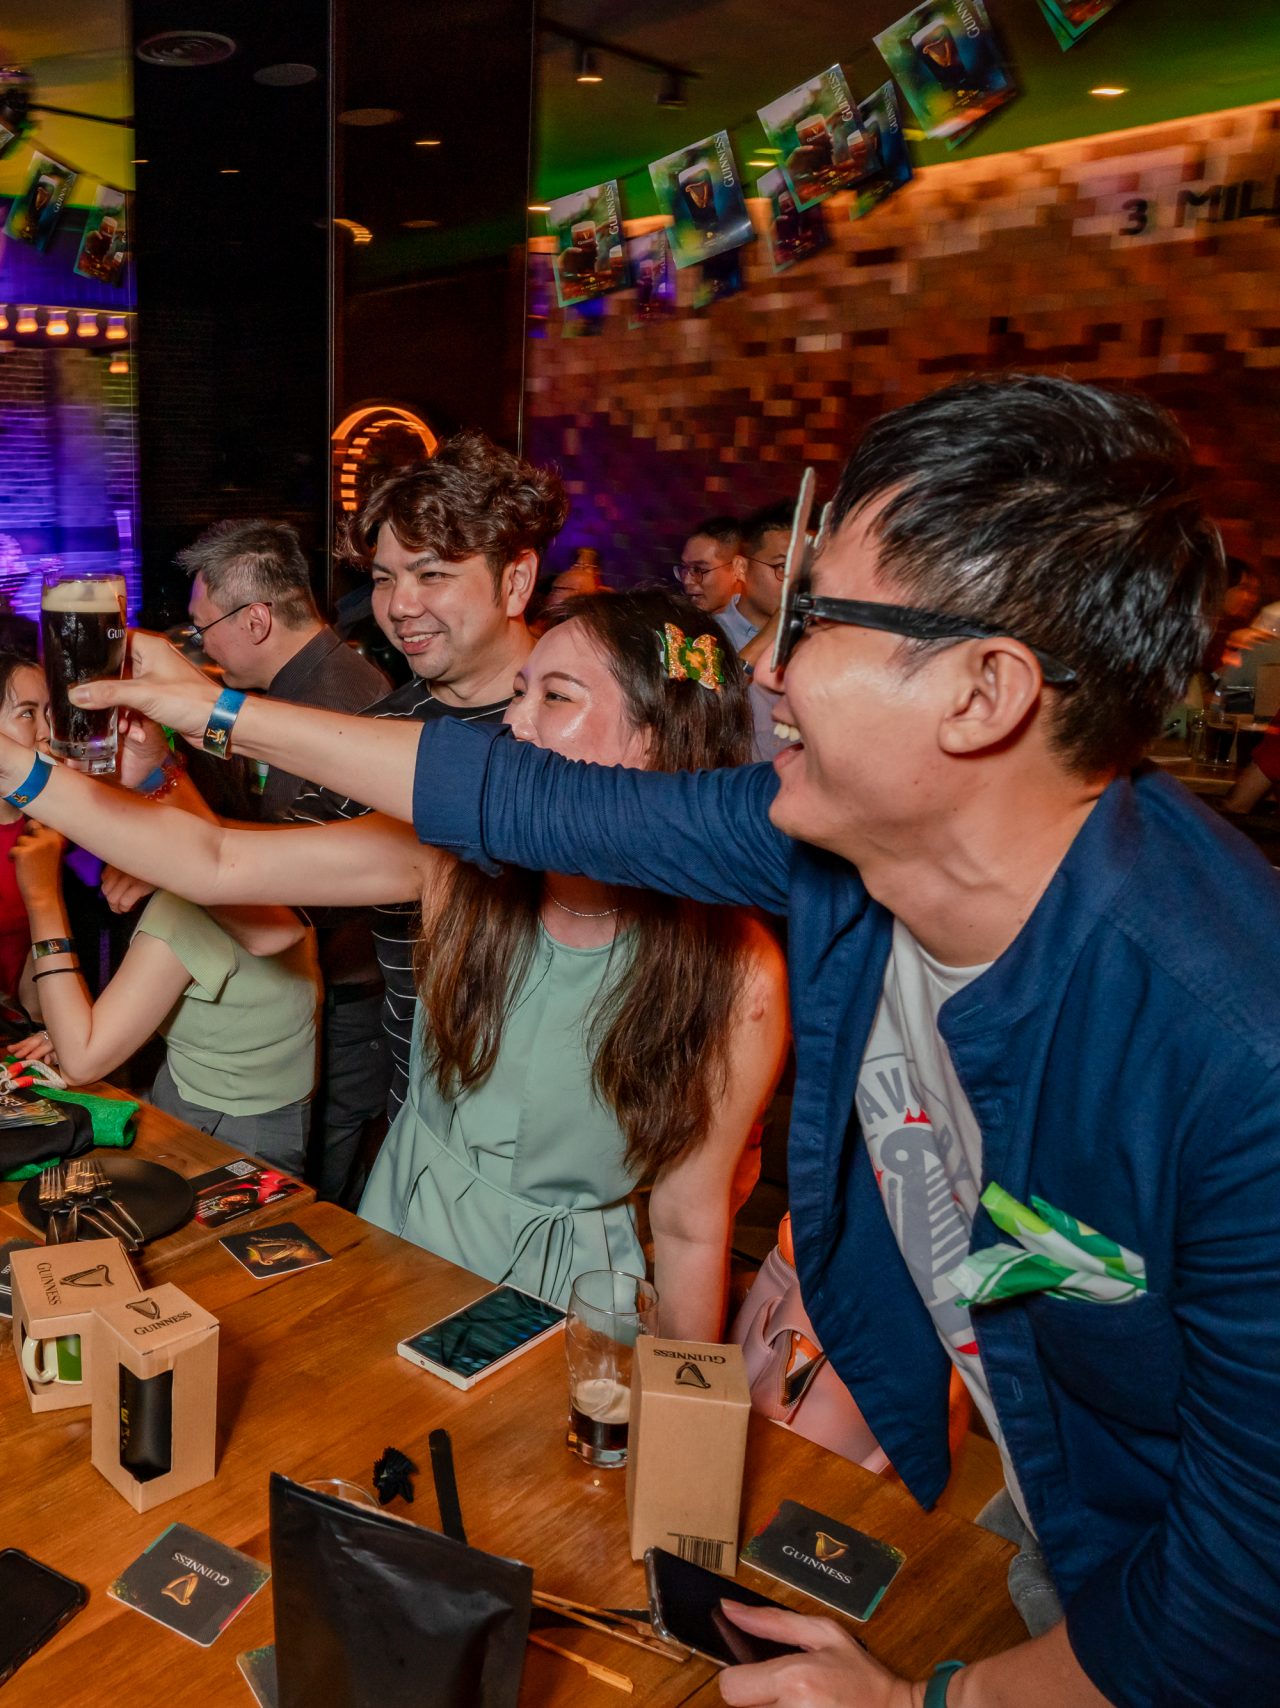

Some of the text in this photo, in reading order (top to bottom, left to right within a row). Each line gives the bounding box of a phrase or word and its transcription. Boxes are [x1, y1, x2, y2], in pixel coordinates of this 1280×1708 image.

[827, 71, 854, 122] GUINNESS
[714, 136, 735, 188] GUINNESS
[608, 184, 619, 236] GUINNESS
[1118, 178, 1280, 236] 3 MIL
[36, 1262, 62, 1306] GUINNESS
[133, 1311, 193, 1336] GUINNESS
[653, 1349, 727, 1365] GUINNESS
[171, 1552, 230, 1587] GUINNESS
[782, 1545, 852, 1584] GUINNESS
